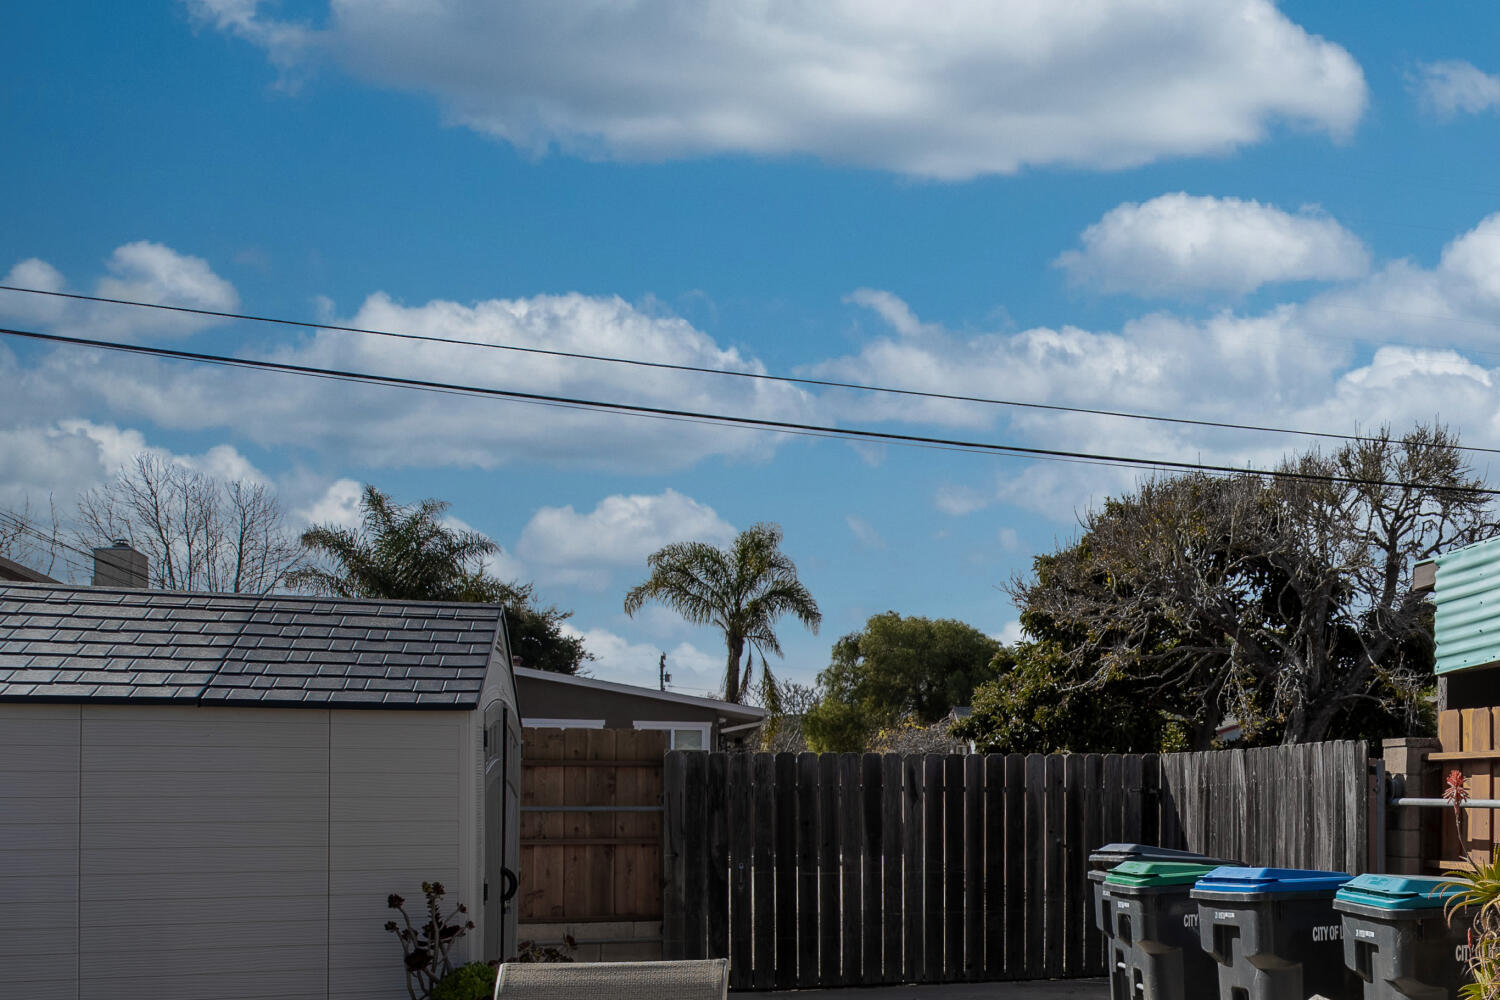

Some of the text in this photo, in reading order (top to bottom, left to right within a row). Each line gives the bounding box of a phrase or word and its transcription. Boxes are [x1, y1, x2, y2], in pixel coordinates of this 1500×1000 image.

[1184, 914, 1199, 928] CITY
[1313, 926, 1329, 942] CITY
[1330, 925, 1339, 941] OF
